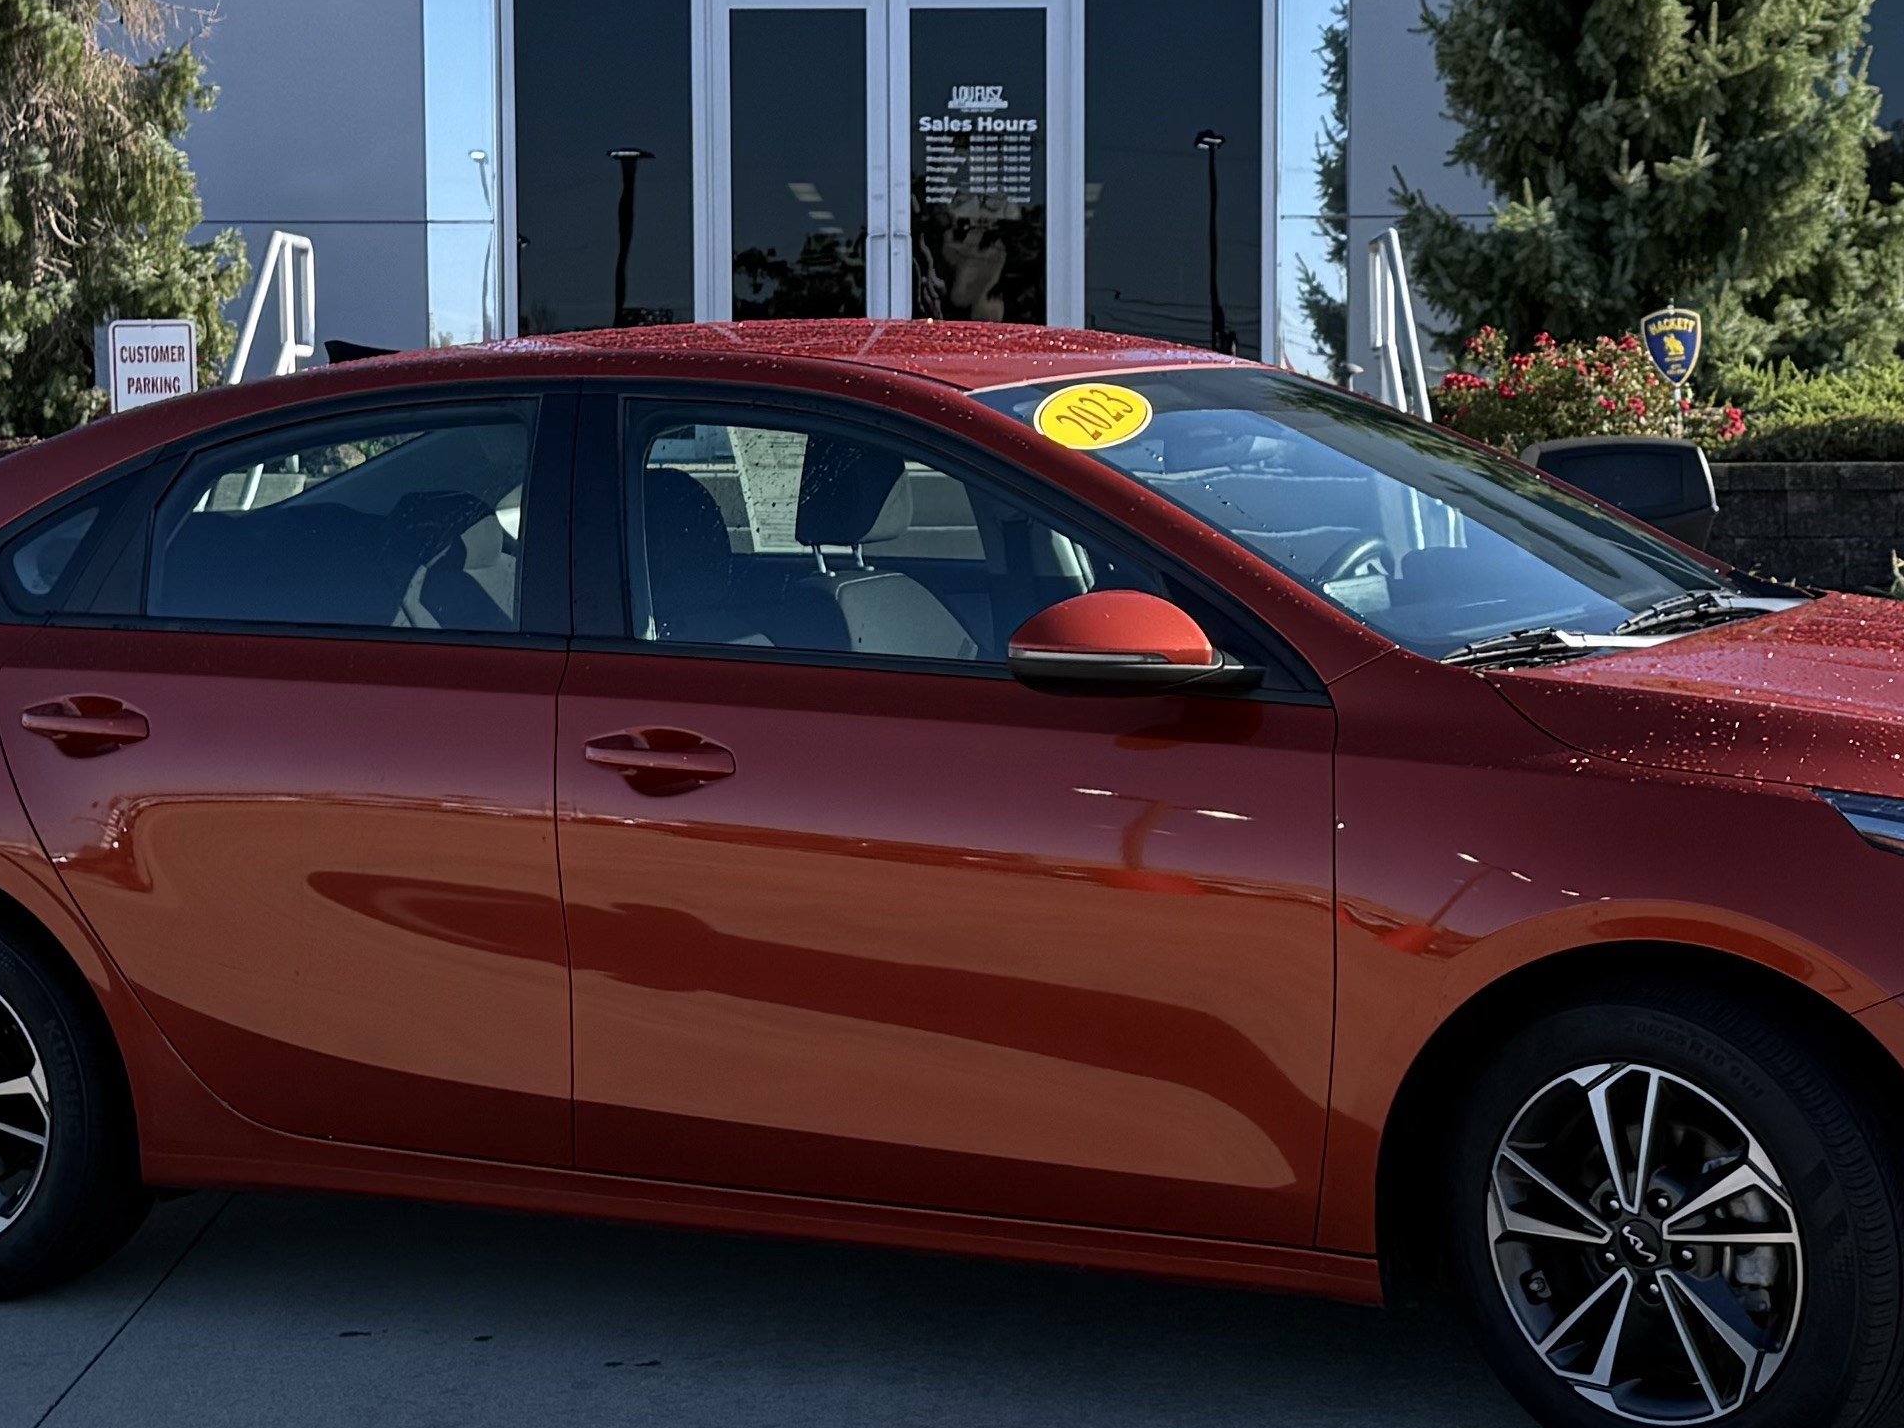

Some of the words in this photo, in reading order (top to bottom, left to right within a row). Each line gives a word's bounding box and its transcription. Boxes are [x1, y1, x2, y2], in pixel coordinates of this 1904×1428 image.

[919, 115, 973, 132] Sales
[977, 115, 1038, 132] Hours
[119, 345, 186, 364] CUSTOMER
[127, 376, 181, 395] PARKING
[1055, 388, 1134, 441] 2023
